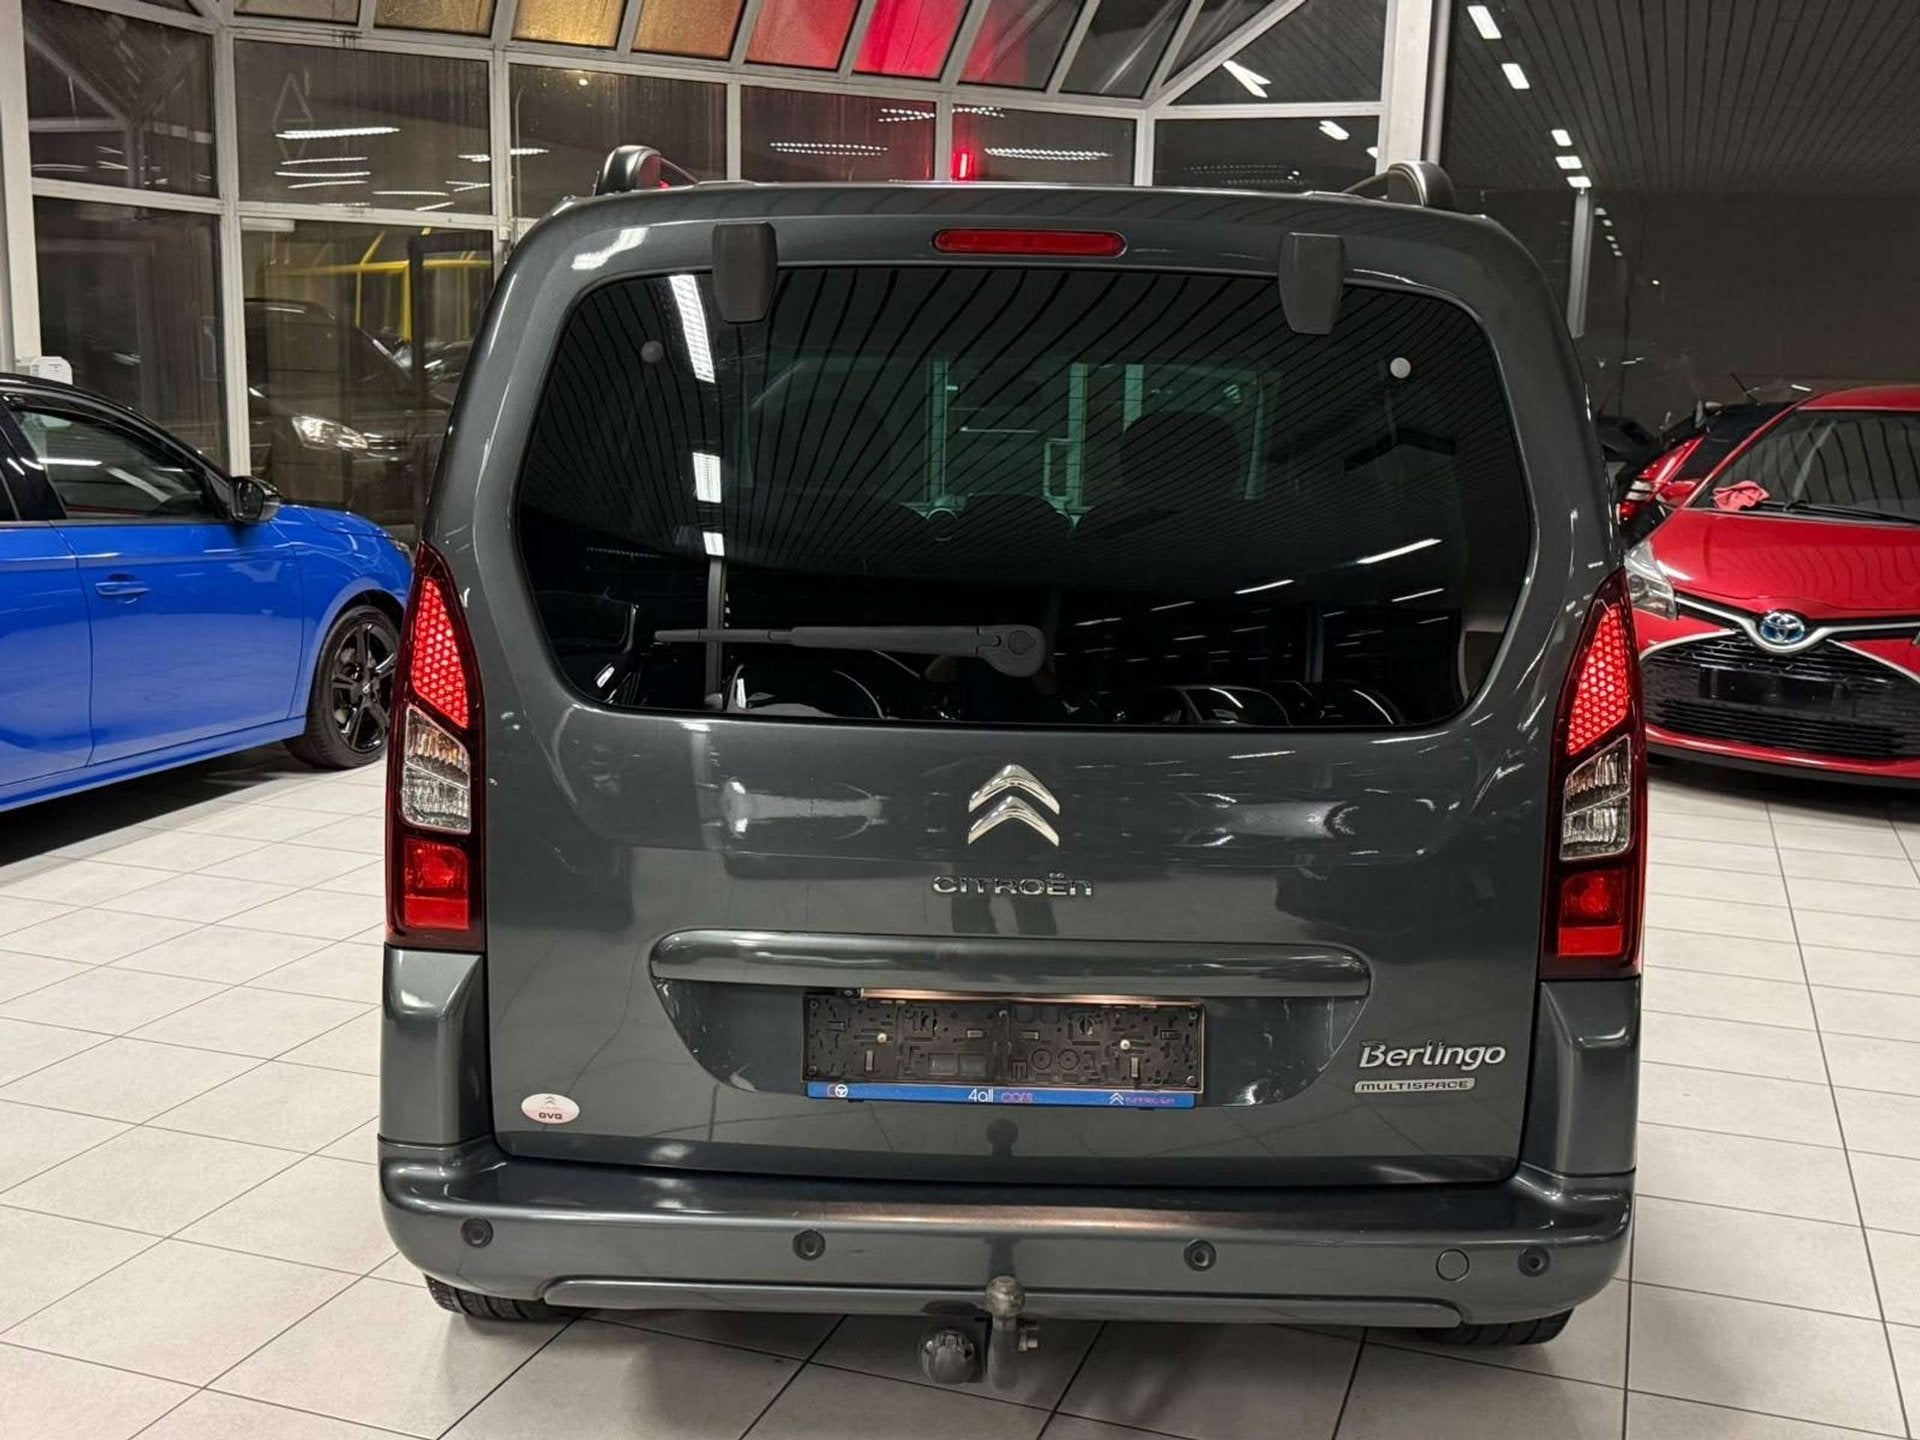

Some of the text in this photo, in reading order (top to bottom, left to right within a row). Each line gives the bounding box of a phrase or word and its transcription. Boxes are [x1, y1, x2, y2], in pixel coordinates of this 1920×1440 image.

[1359, 1040, 1507, 1071] Berlingo
[1361, 1080, 1469, 1091] MULTISPACE
[968, 1088, 994, 1103] 4all
